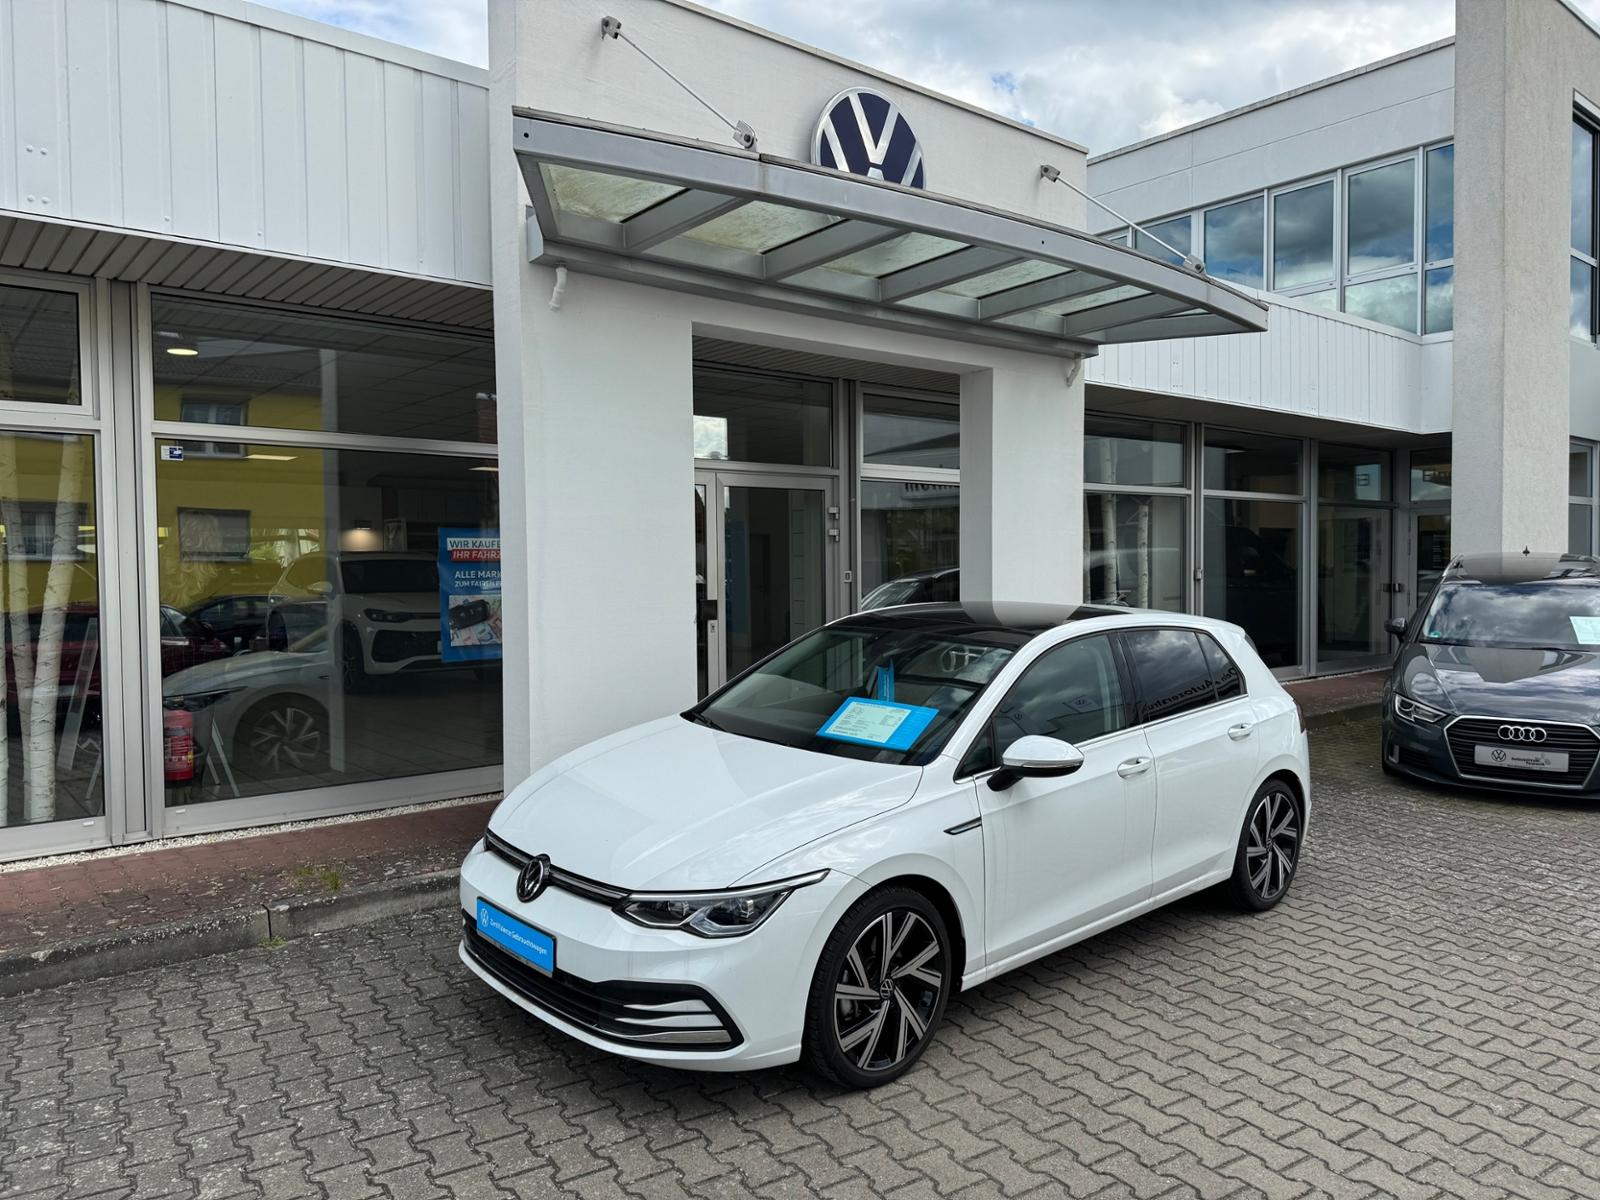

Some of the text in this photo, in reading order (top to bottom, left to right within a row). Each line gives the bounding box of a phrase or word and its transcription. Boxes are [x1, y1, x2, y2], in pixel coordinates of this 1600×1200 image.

[449, 540, 469, 549] WIR
[453, 551, 470, 559] IHR
[455, 570, 476, 579] ALLE
